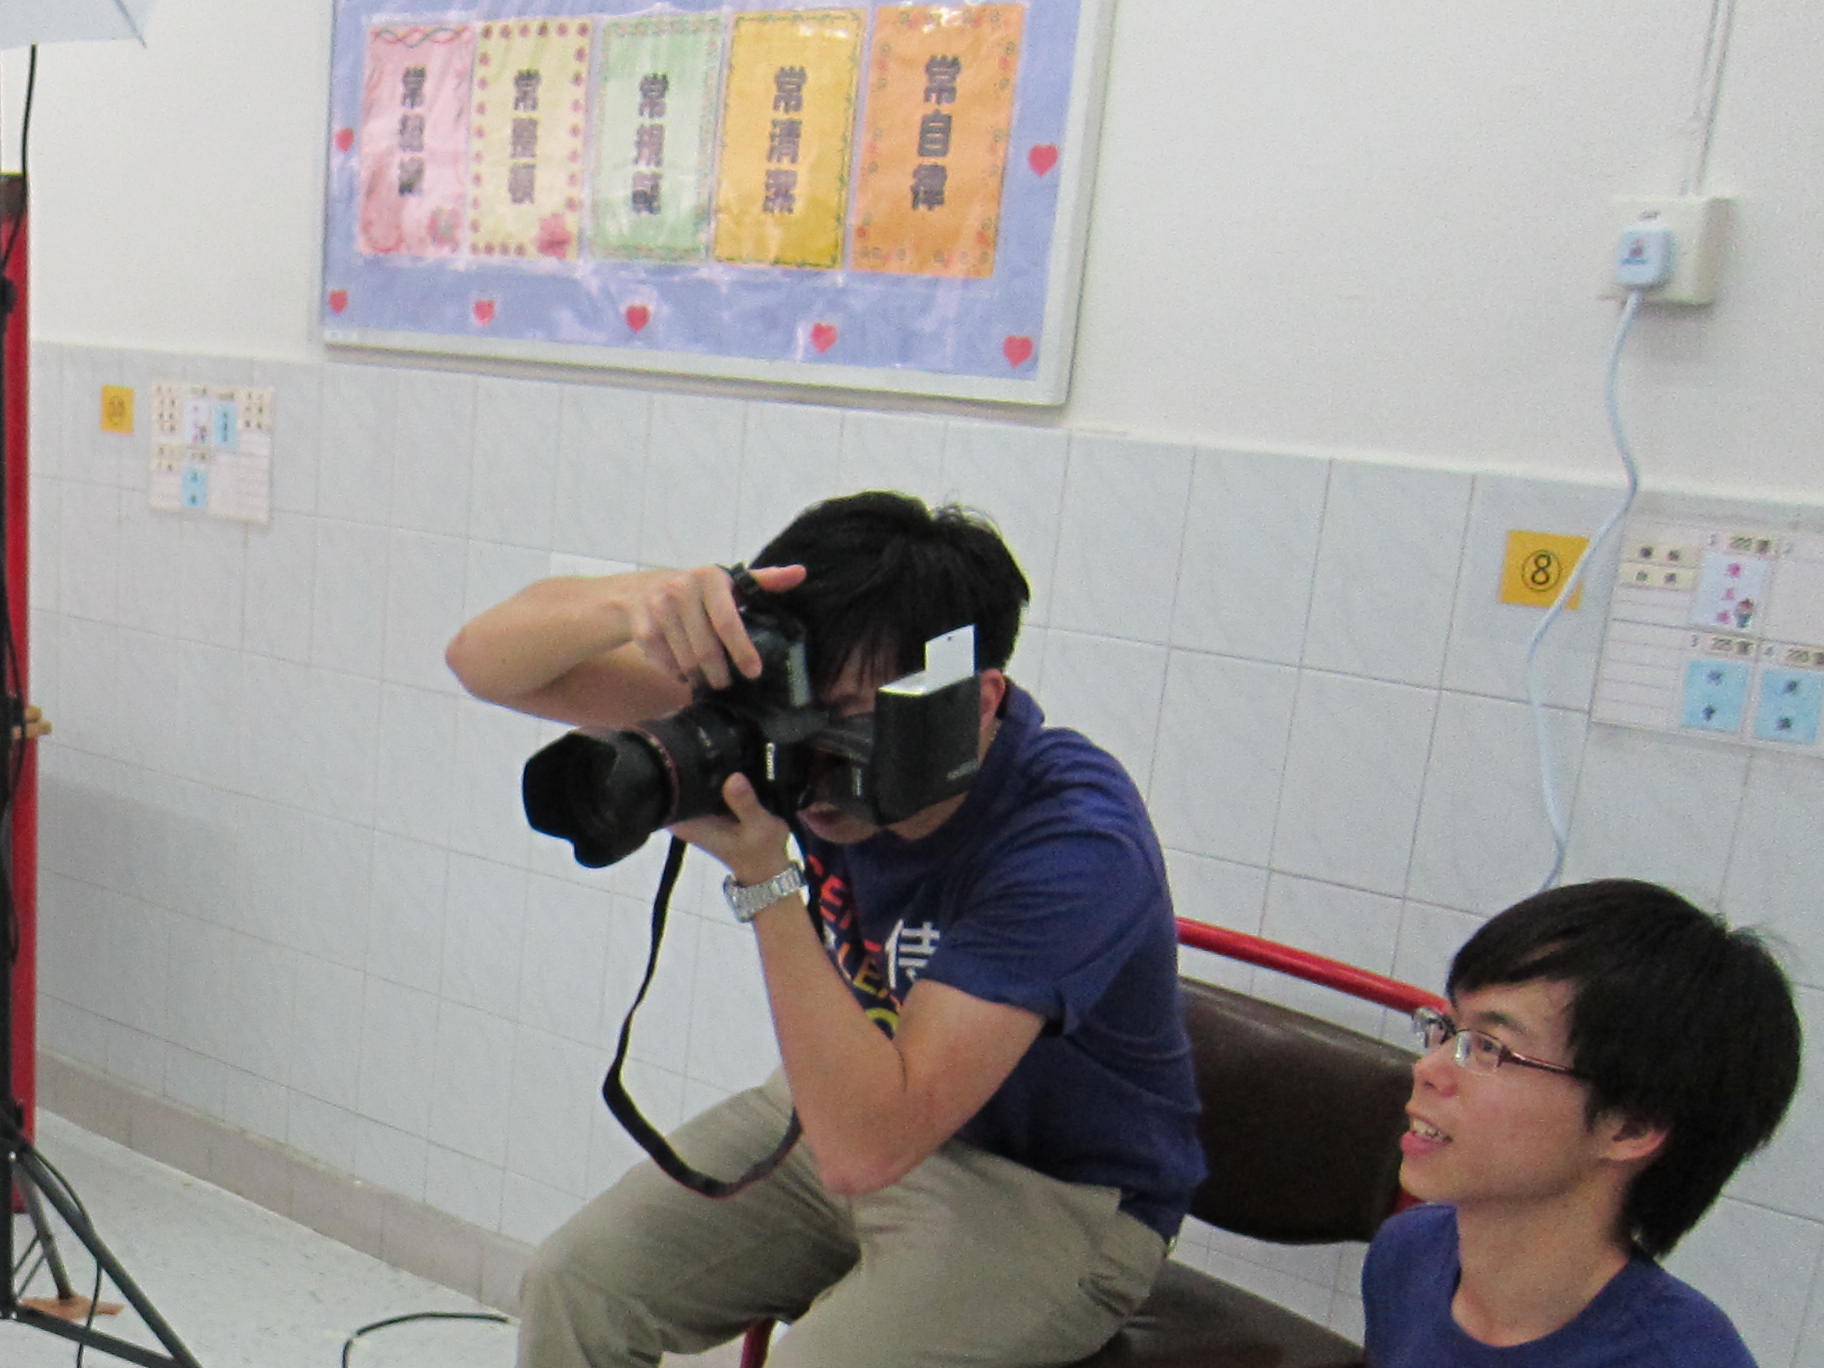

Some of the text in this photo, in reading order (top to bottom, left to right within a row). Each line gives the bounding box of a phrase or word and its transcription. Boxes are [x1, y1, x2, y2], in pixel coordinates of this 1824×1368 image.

[763, 65, 808, 216] 常清潔
[909, 54, 962, 212] 常自律
